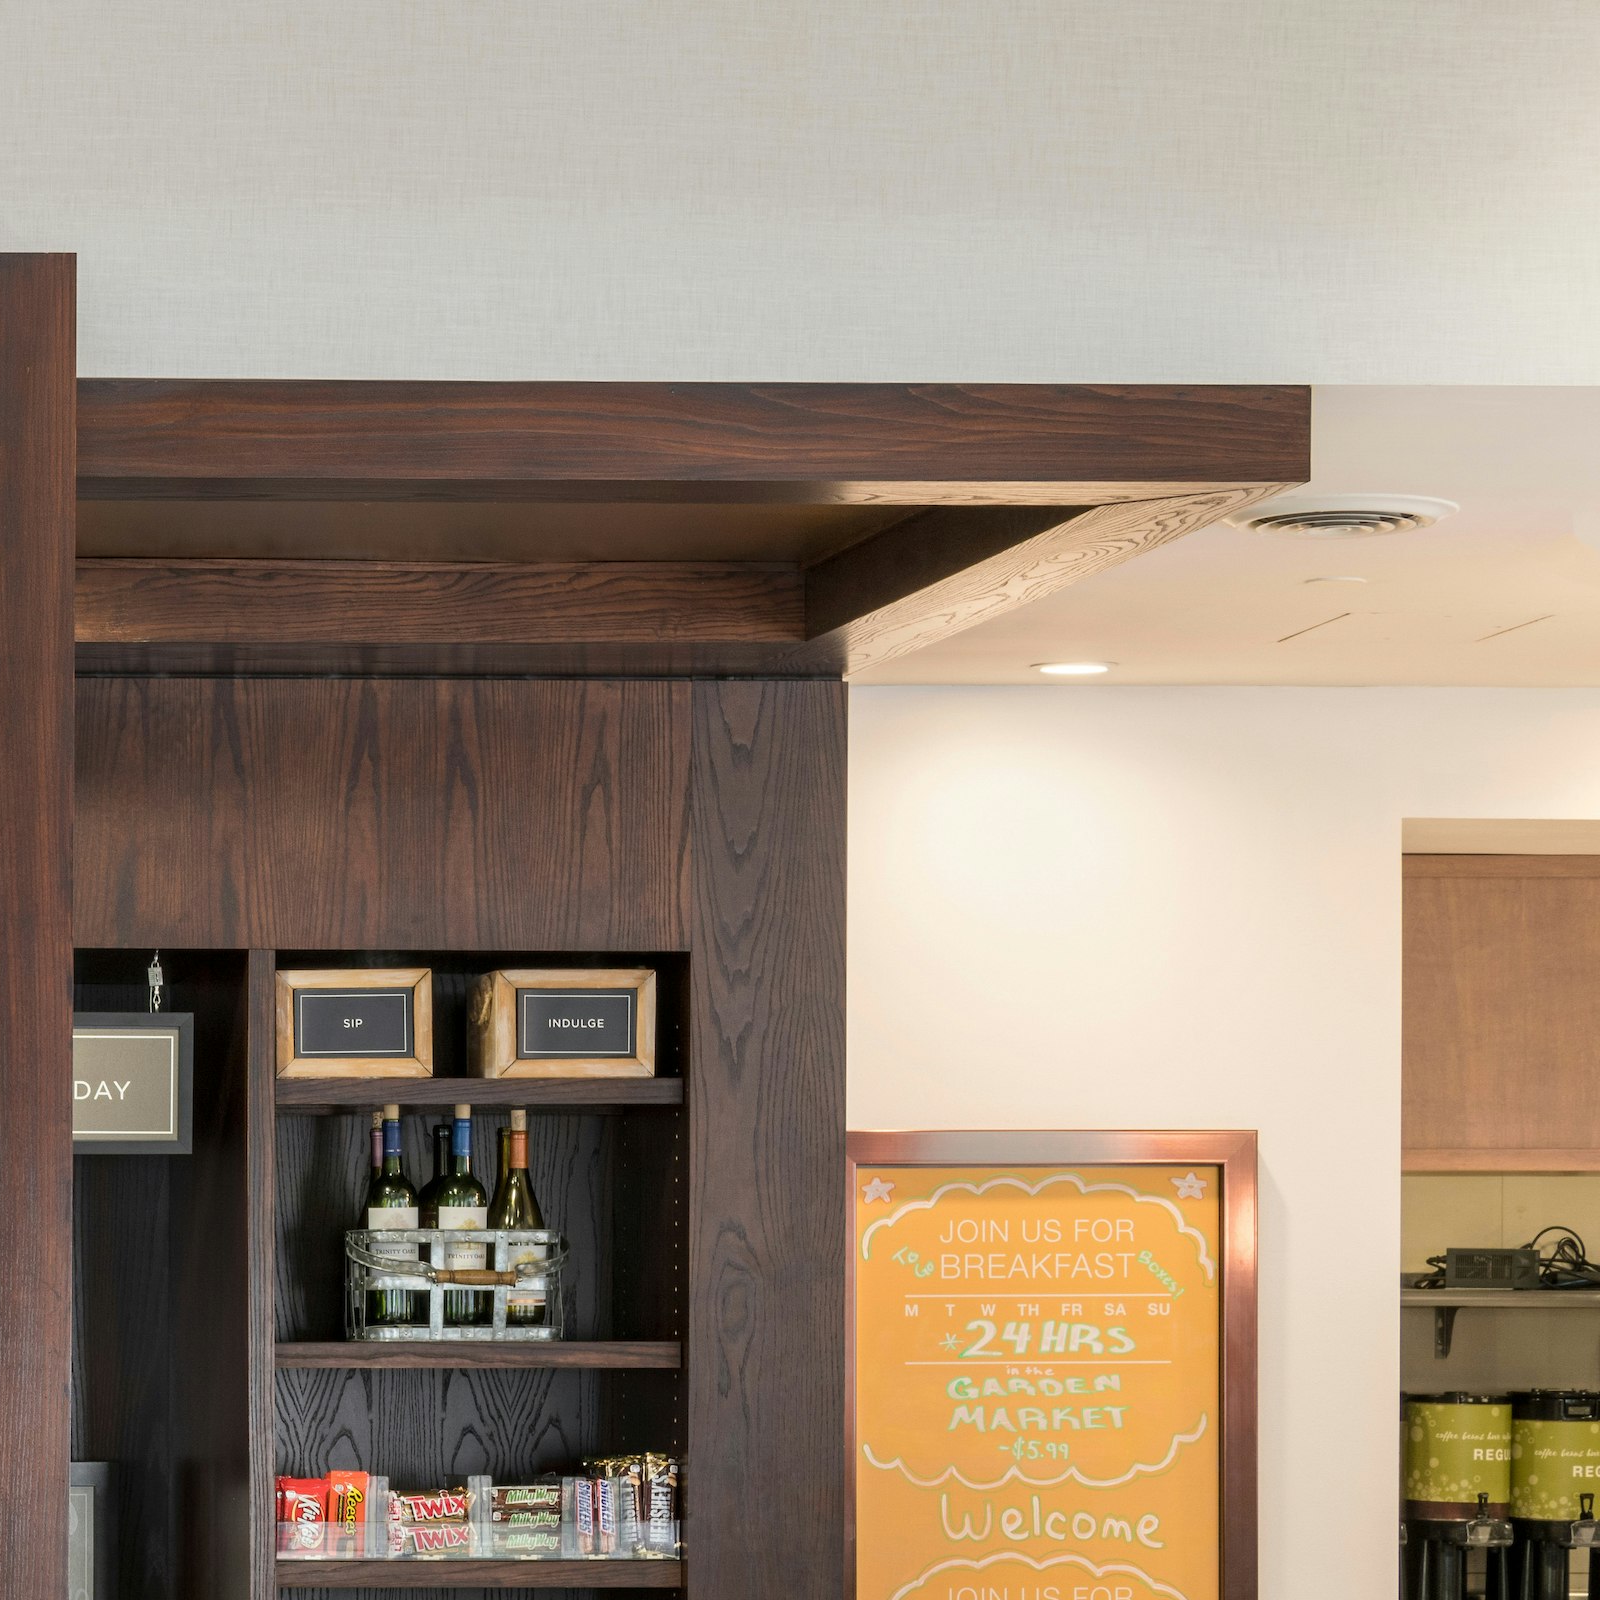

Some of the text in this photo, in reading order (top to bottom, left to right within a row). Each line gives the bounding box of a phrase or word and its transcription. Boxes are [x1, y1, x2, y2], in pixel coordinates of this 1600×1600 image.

[343, 1018, 363, 1029] SIP
[548, 1018, 605, 1029] INDULGE
[73, 1080, 131, 1101] DAY
[939, 1219, 1134, 1243] JOIN US FOR
[940, 1252, 1135, 1280] BREAKFAST
[905, 1303, 1170, 1317] M T W TH FR SA SU
[1039, 1320, 1136, 1355] HRS
[1006, 1365, 1055, 1376] in the
[946, 1374, 1121, 1400] GARDEN
[948, 1404, 1130, 1433] MARKET
[578, 1482, 591, 1534] SNICKERS
[941, 1493, 1164, 1548] Welcome
